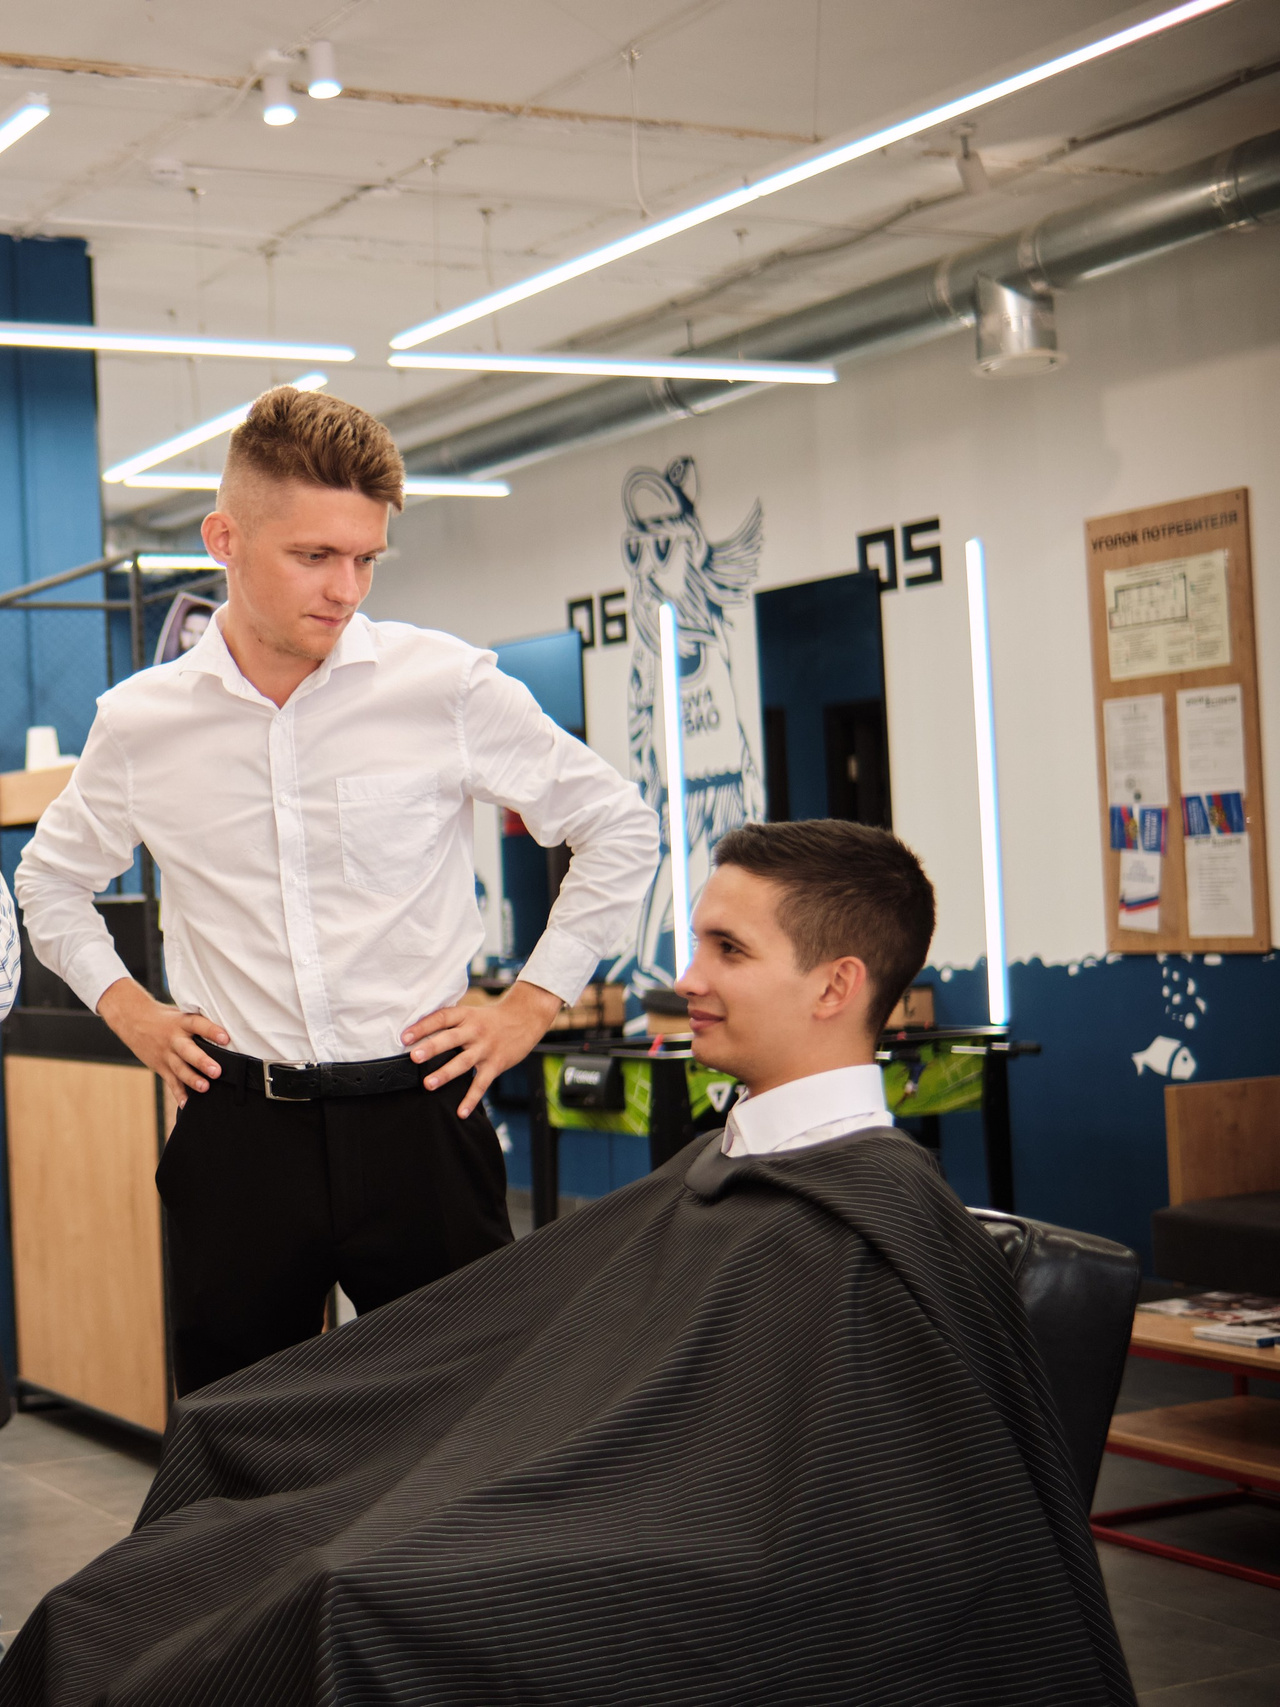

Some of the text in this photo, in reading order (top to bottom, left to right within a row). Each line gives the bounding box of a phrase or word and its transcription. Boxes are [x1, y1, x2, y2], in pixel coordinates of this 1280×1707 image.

[856, 515, 943, 590] 05
[1091, 510, 1238, 553] УГОЛОК ПОТРЕБИТЕЛЯ
[567, 589, 628, 649] 06
